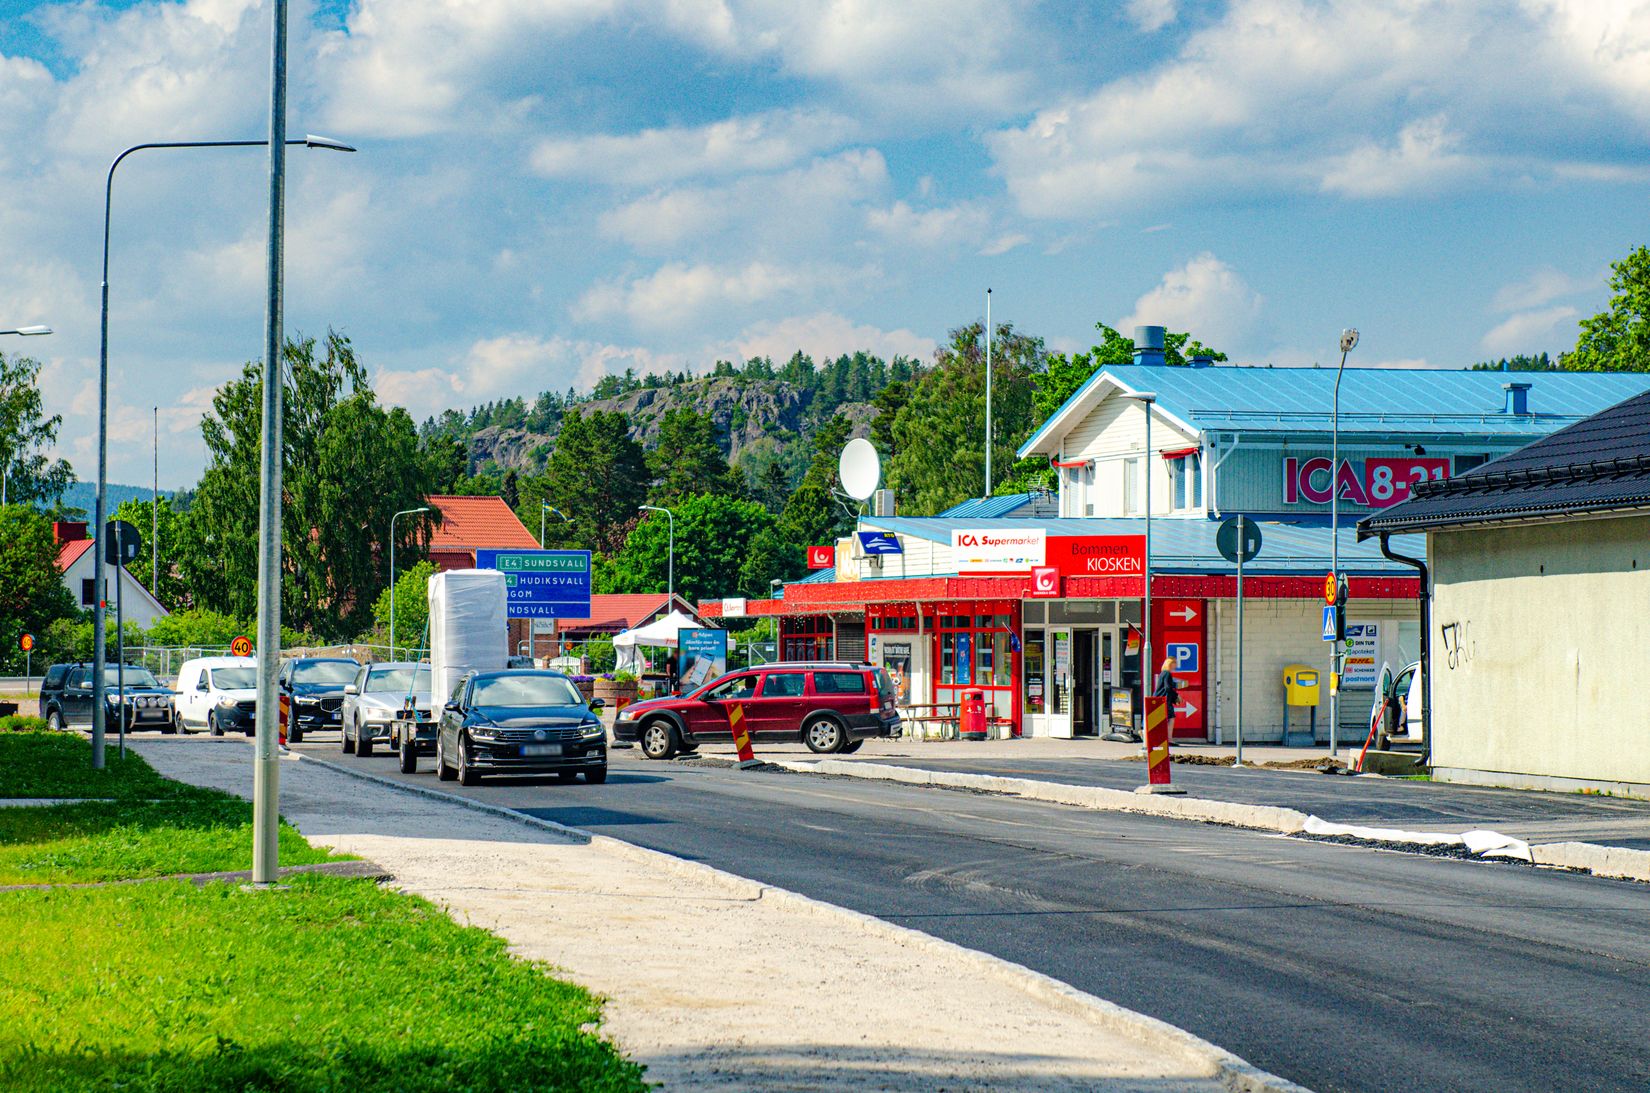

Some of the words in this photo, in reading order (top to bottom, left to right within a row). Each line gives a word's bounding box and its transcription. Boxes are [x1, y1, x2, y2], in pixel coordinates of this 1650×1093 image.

[1283, 456, 1370, 505] ICA
[958, 535, 979, 547] ICA
[981, 535, 1040, 548] Supermarket
[1071, 543, 1129, 555] Bommen
[524, 559, 584, 567] SUNDSVALL
[1087, 557, 1141, 571] KIOSKEN
[520, 577, 584, 585] HUDIKSVALL
[506, 590, 532, 598] GOM
[1327, 580, 1334, 597] 30
[509, 606, 555, 614] NDSVALL
[234, 641, 248, 653] 40
[1176, 646, 1191, 668] P
